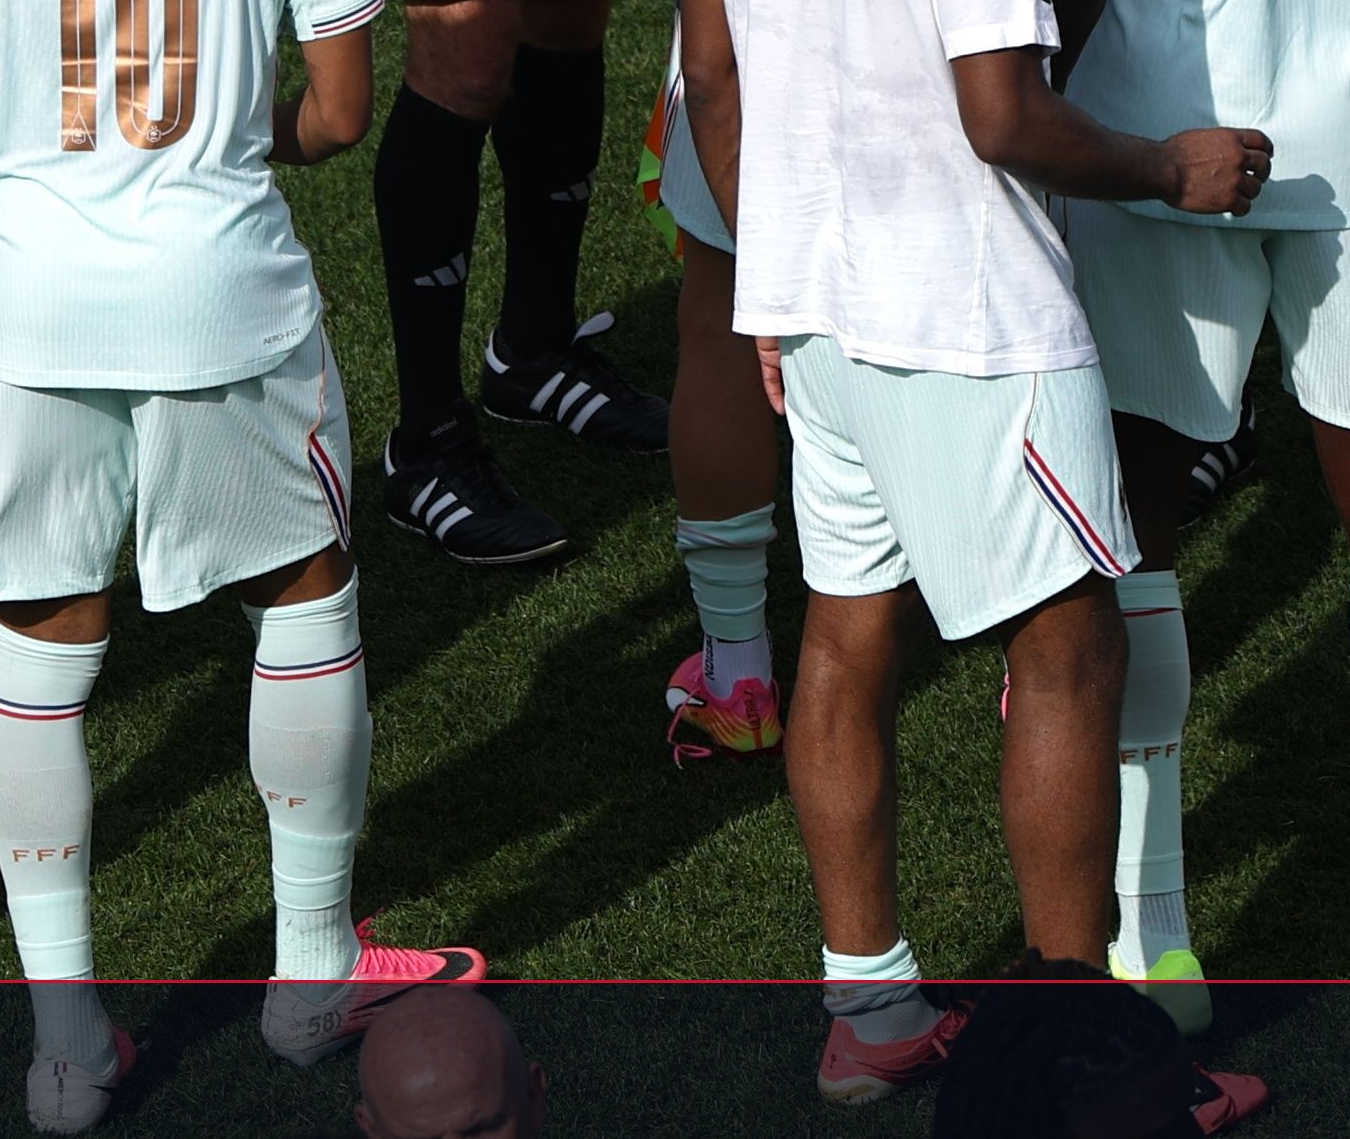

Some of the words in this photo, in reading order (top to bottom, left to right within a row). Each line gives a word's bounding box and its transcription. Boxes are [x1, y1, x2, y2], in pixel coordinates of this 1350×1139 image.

[1120, 742, 1178, 765] FFF
[255, 783, 308, 809] FF
[12, 844, 81, 863] FFF
